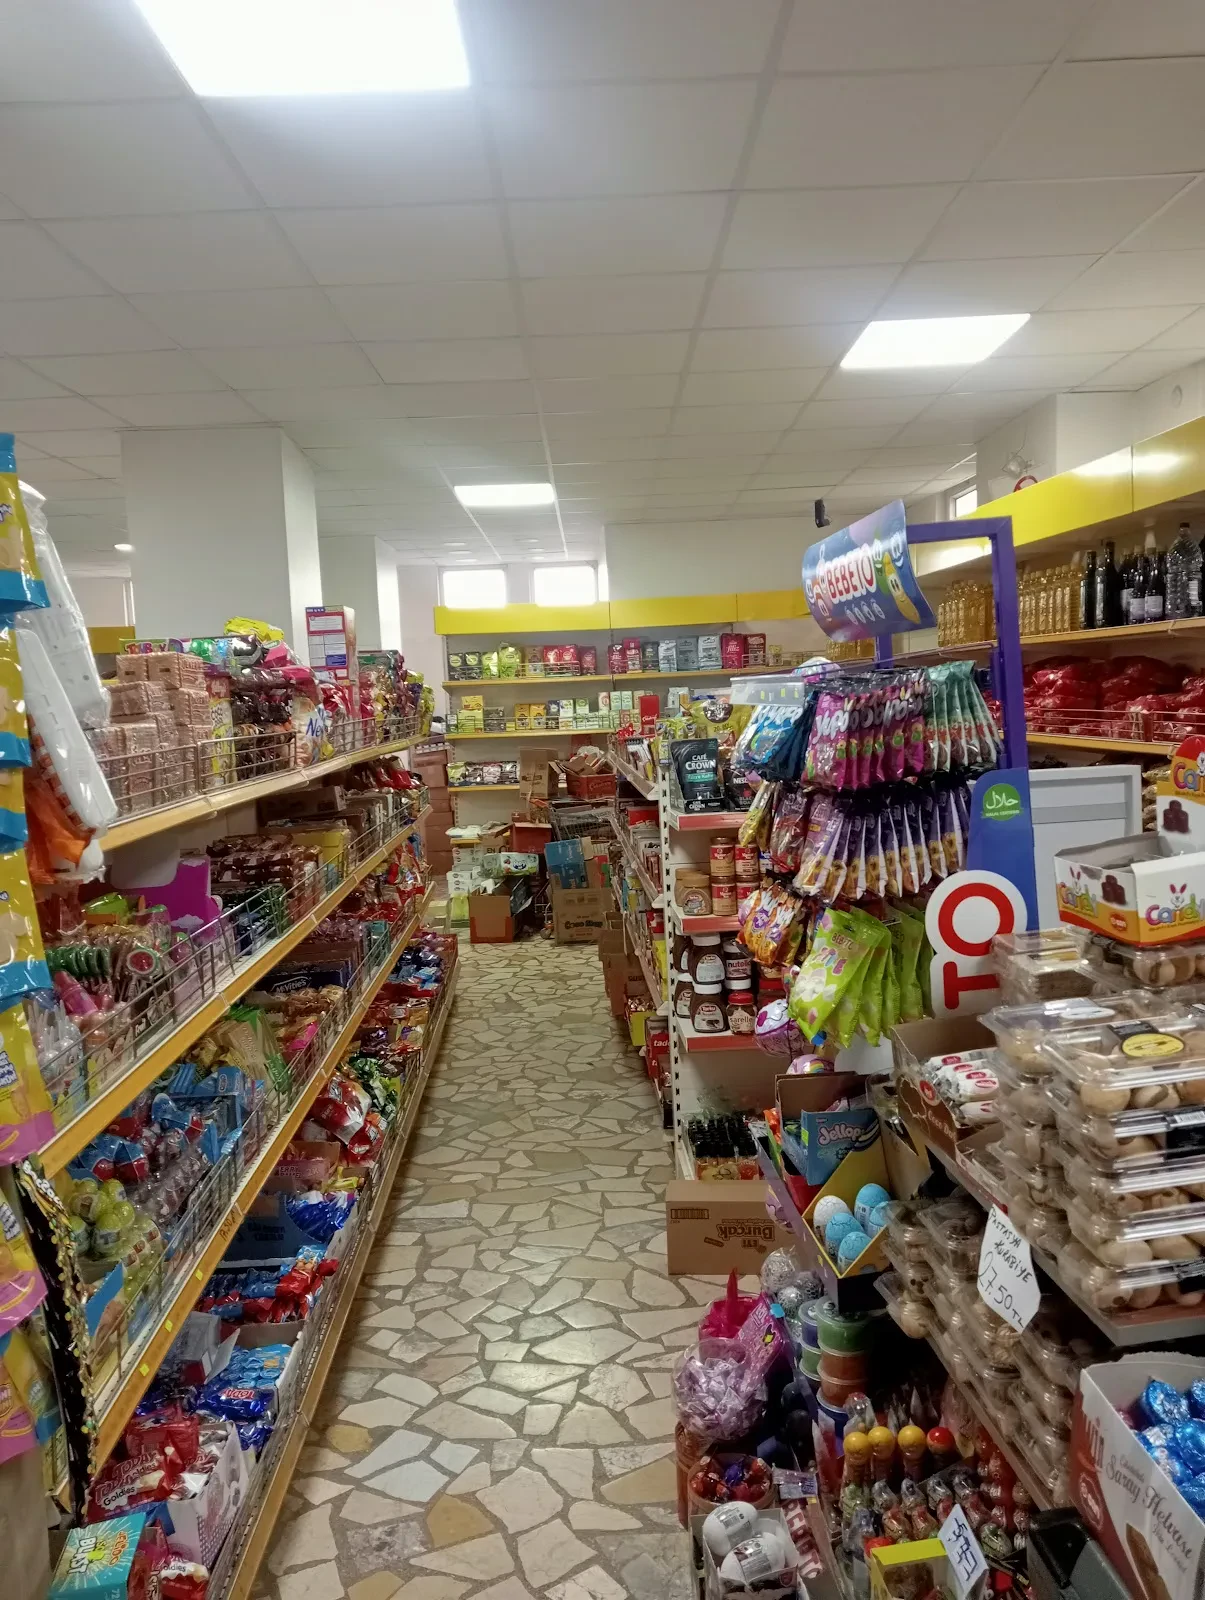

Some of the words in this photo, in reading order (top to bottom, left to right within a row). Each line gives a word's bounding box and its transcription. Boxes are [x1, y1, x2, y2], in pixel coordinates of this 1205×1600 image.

[825, 553, 876, 600] BEBETO
[685, 759, 716, 770] CROWN
[986, 791, 1019, 810] حلال
[276, 979, 307, 993] McVitie's
[1106, 1454, 1141, 1504] Saray
[103, 1486, 136, 1506] Goldies
[67, 1536, 97, 1575] BLAST
